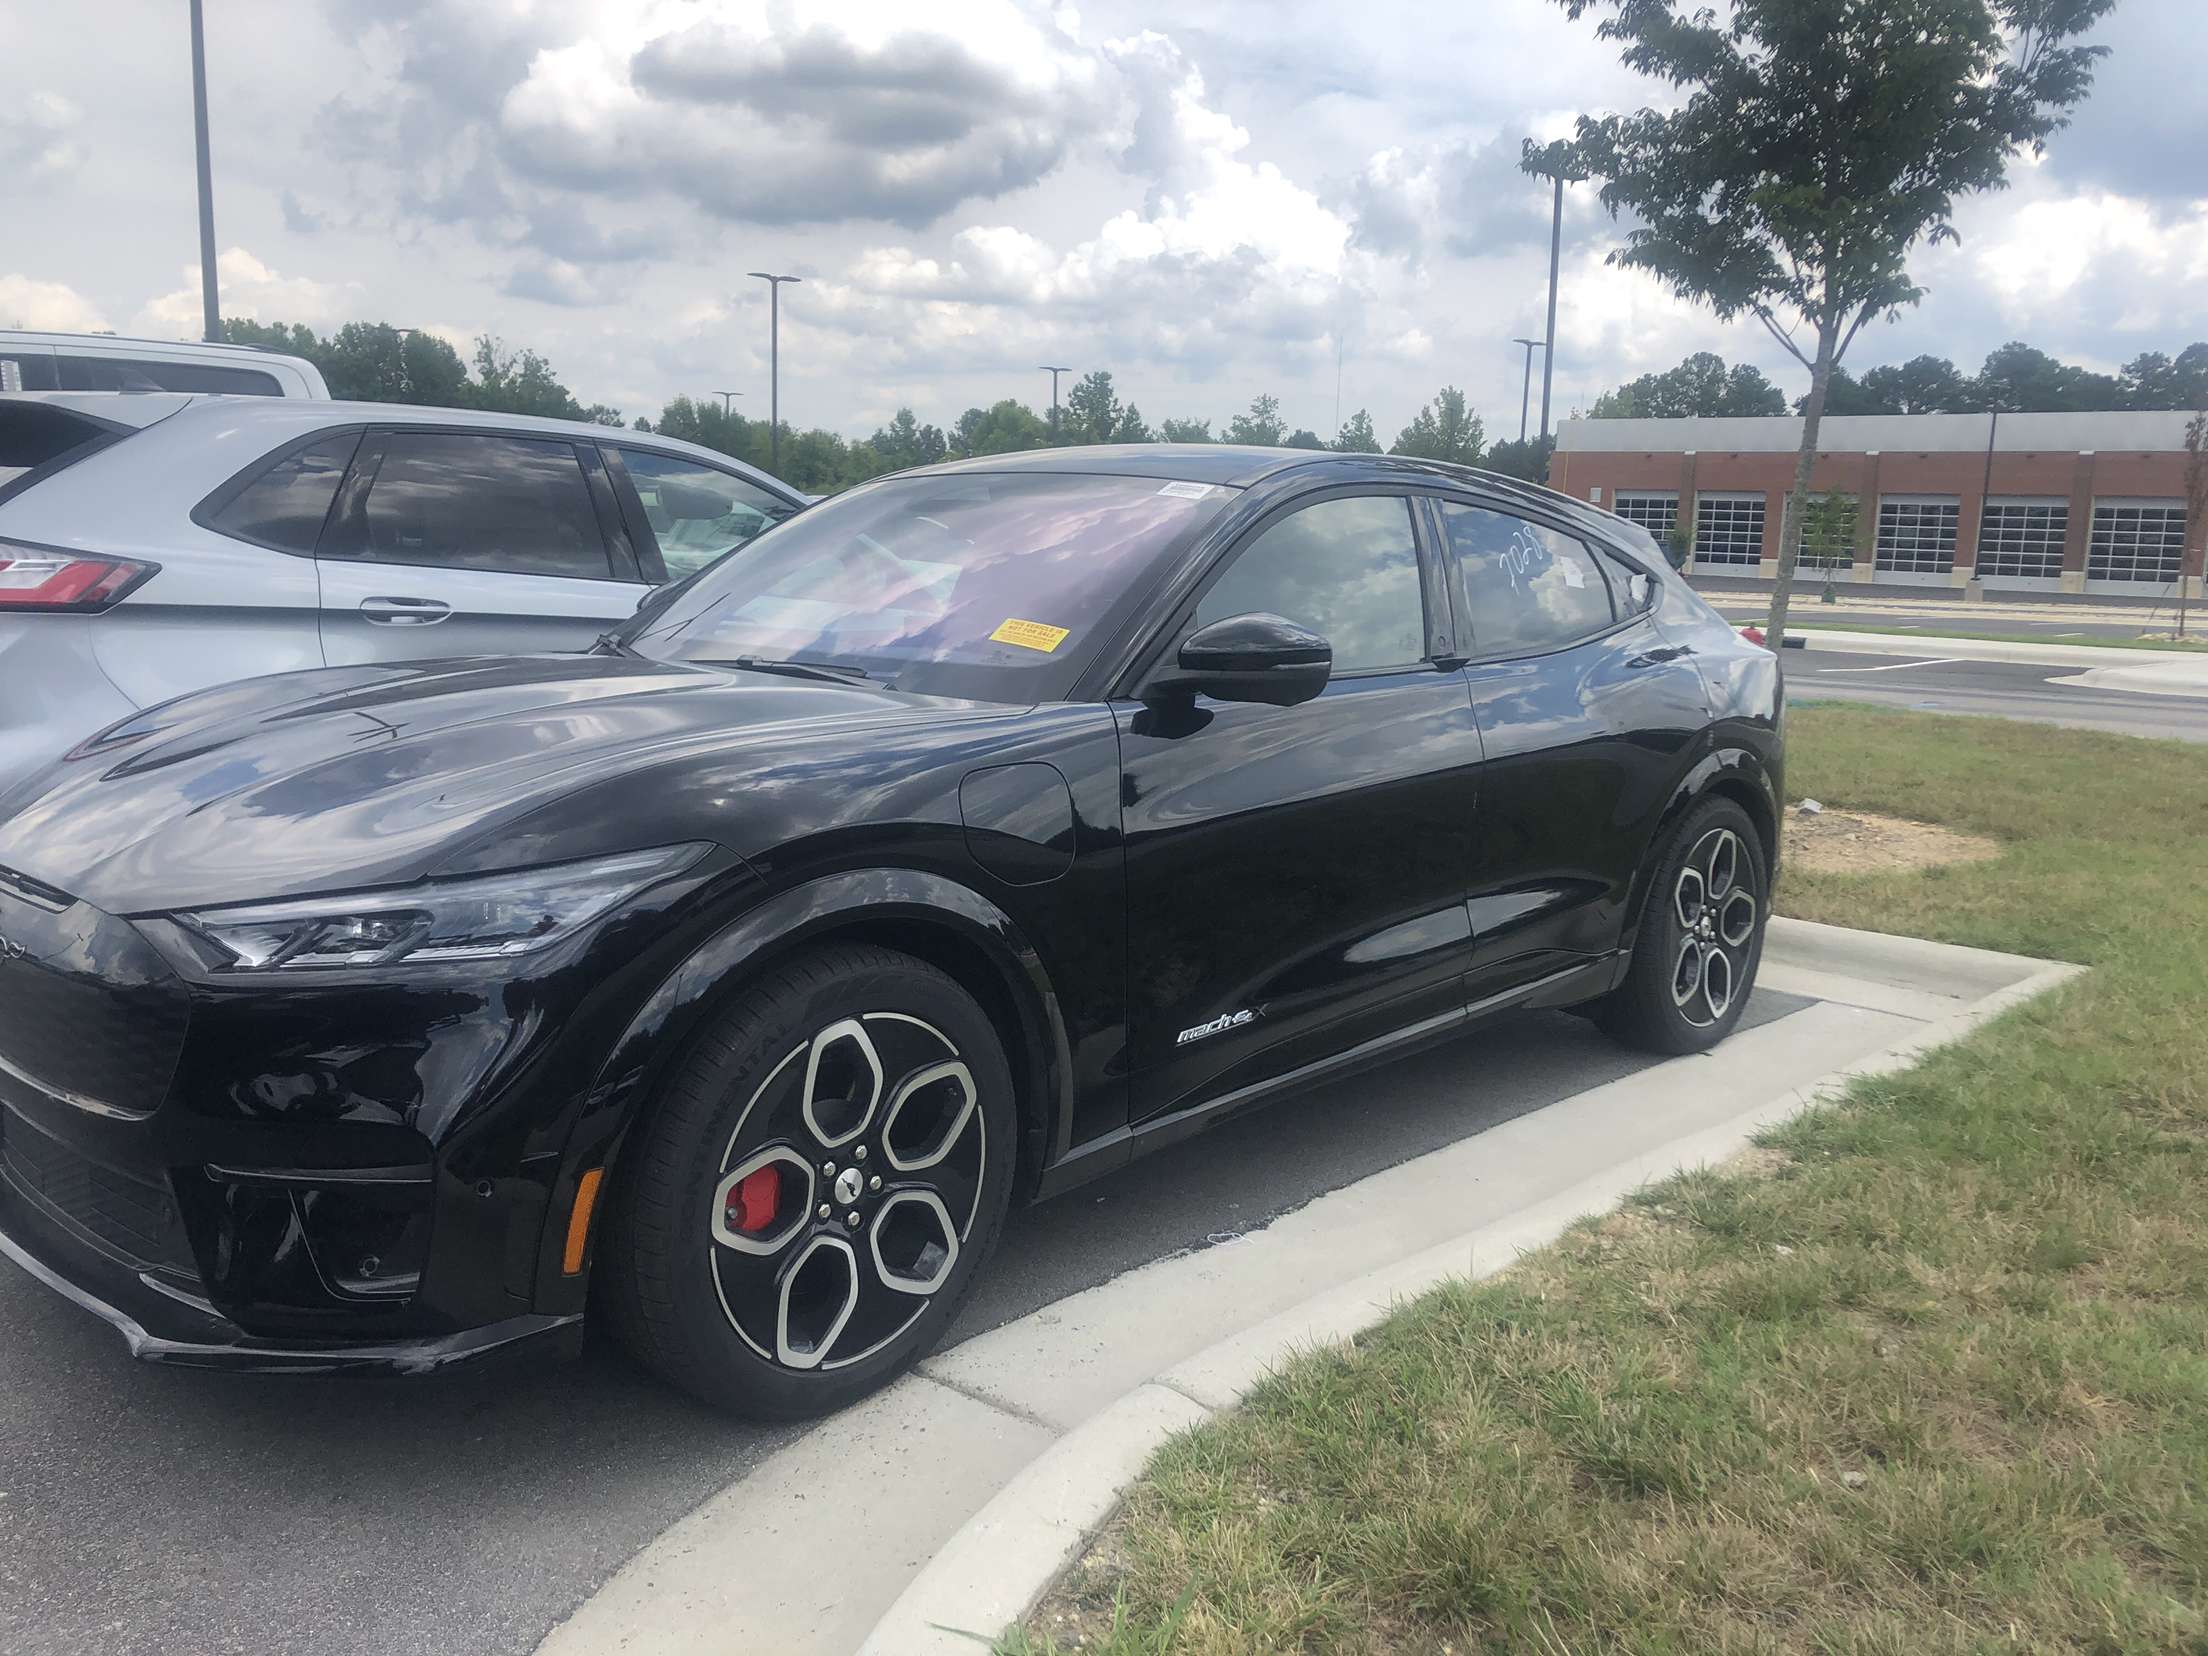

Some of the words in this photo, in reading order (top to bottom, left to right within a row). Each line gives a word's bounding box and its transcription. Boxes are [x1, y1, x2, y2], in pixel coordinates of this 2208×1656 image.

[1499, 526, 1543, 596] 7028
[1039, 630, 1057, 638] SALE
[1176, 1009, 1253, 1043] mach-e
